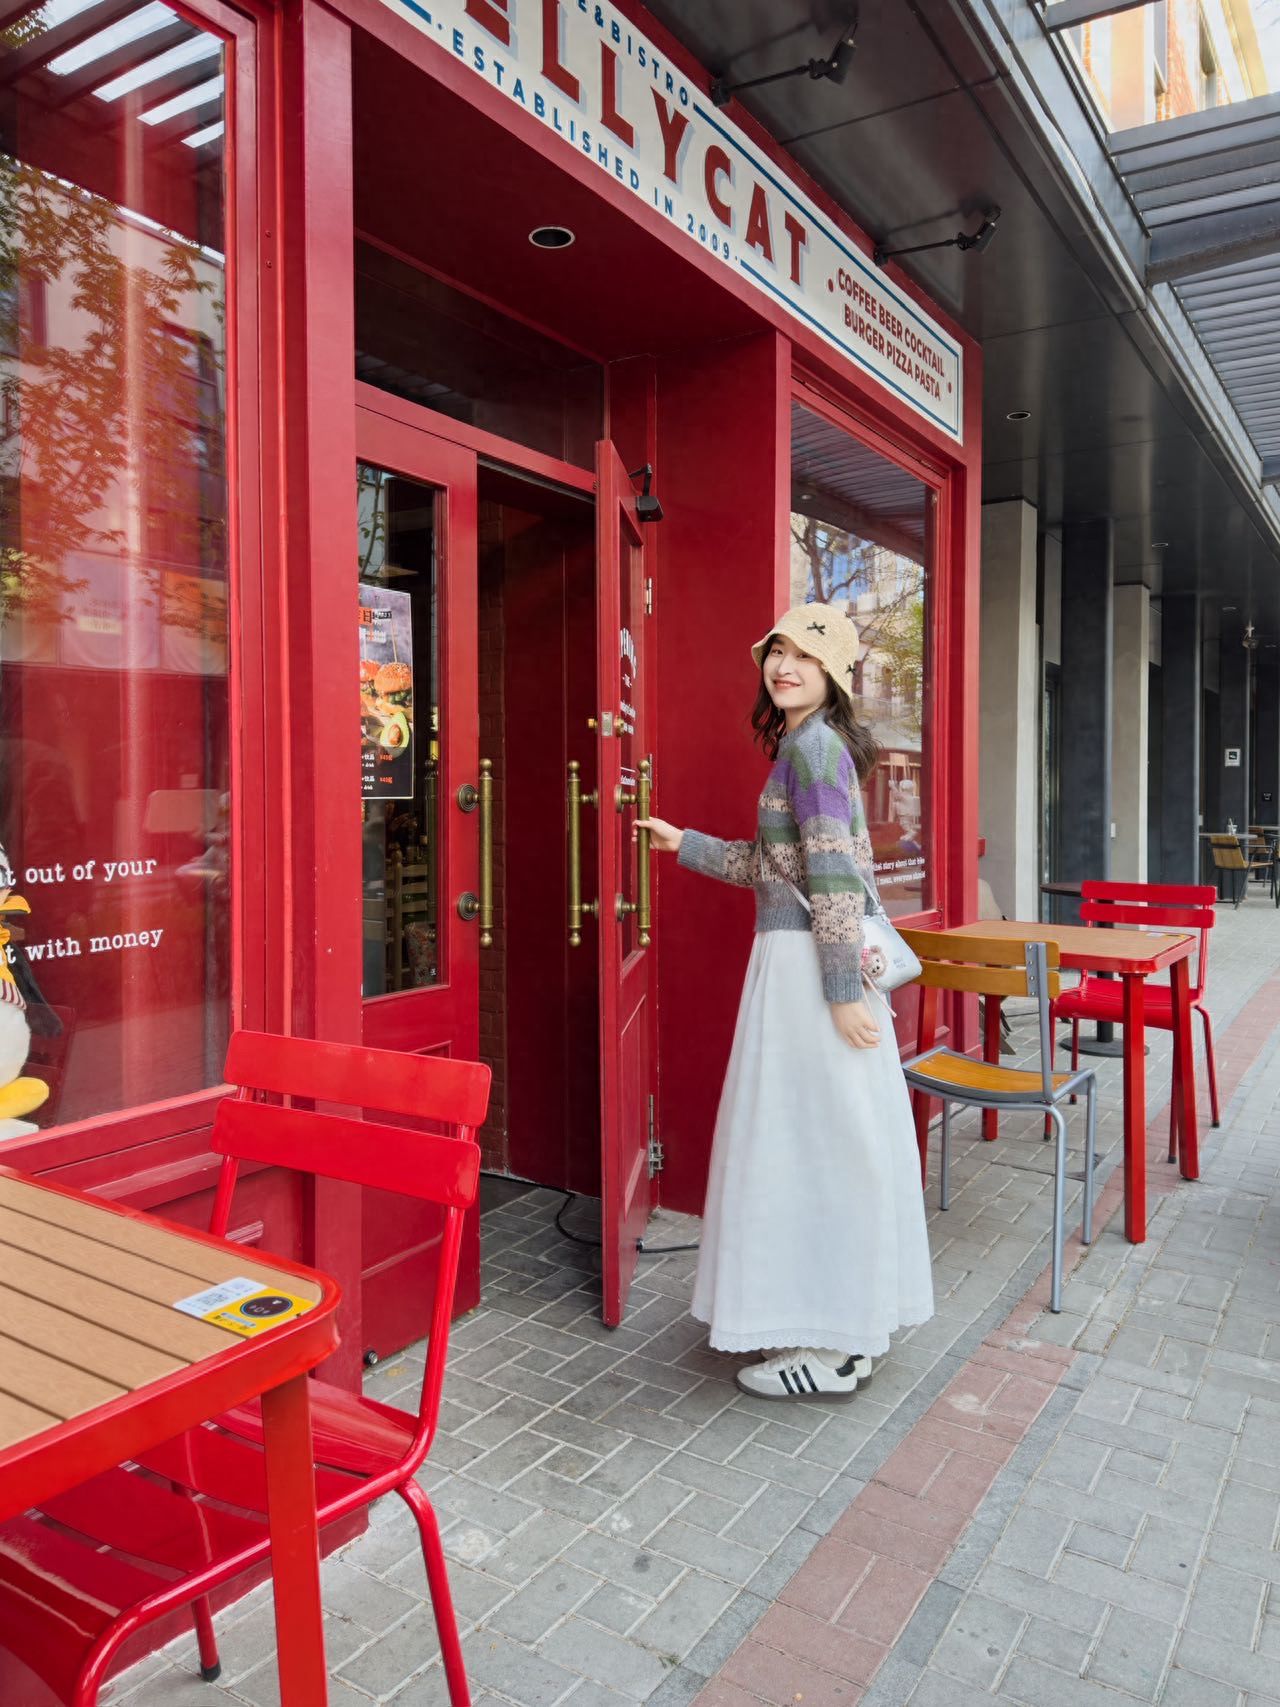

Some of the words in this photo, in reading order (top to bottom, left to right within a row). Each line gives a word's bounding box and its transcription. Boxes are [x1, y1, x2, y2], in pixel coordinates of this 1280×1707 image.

[452, 27, 639, 191] ESTABLISHED
[654, 187, 673, 218] IN
[687, 213, 730, 260] 2009
[838, 267, 877, 320] COFFEE
[878, 303, 903, 342] BEER
[904, 327, 945, 378] COCKTAIL
[844, 303, 885, 356] BURGER
[886, 340, 914, 379] PIZZA
[914, 363, 942, 401] PASTA
[25, 863, 66, 884] out
[72, 860, 96, 881] of
[103, 858, 157, 882] your
[25, 936, 82, 961] with
[90, 928, 163, 953] money
